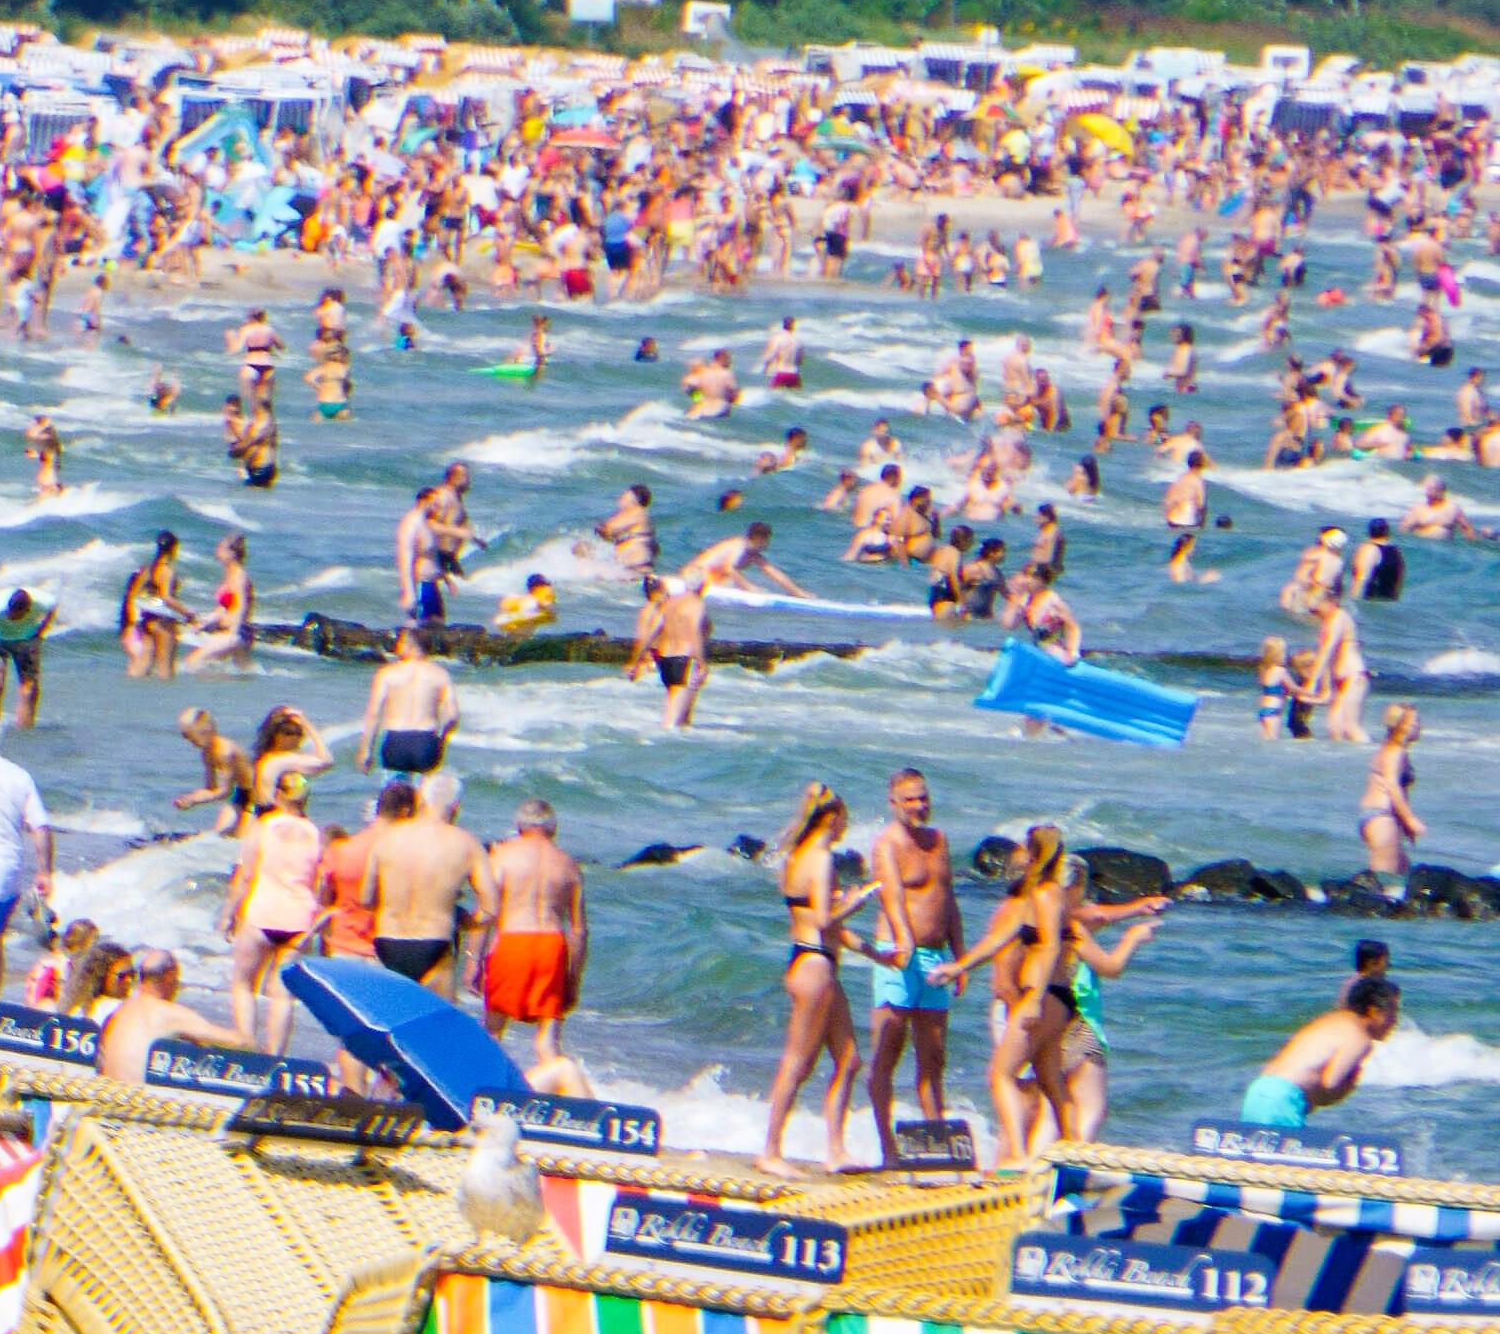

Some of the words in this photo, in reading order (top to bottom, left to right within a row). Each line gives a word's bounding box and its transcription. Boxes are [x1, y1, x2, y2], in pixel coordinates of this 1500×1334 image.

[50, 1027, 97, 1057] 156
[280, 1071, 326, 1096] 155
[608, 1117, 657, 1146] 154
[1345, 1144, 1400, 1172] 152
[708, 1220, 793, 1253] Beach
[780, 1234, 842, 1273] 113
[1045, 1247, 1122, 1284] Rikki
[1122, 1254, 1213, 1288] Beach
[1202, 1267, 1269, 1303] 112
